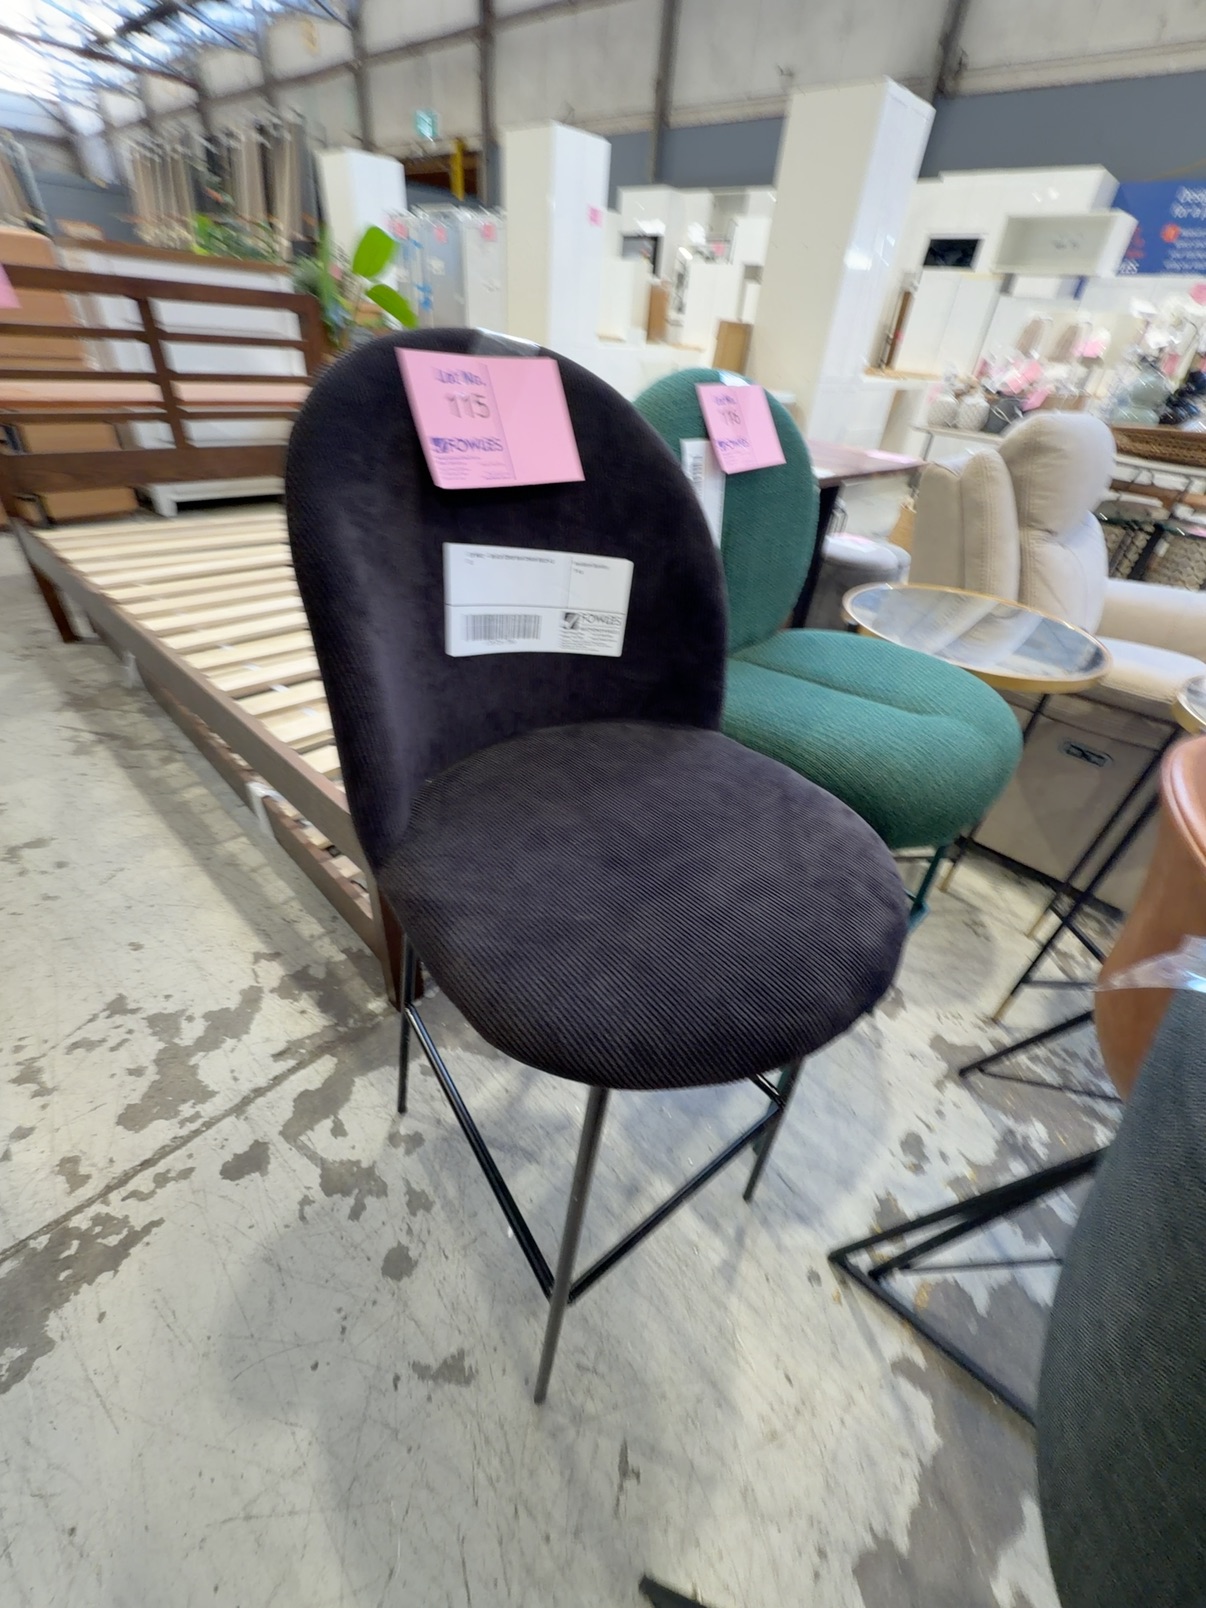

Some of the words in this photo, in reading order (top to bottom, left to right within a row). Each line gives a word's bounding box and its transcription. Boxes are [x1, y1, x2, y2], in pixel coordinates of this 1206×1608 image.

[435, 369, 460, 385] Lot
[461, 370, 487, 386] No.
[445, 393, 490, 418] 115
